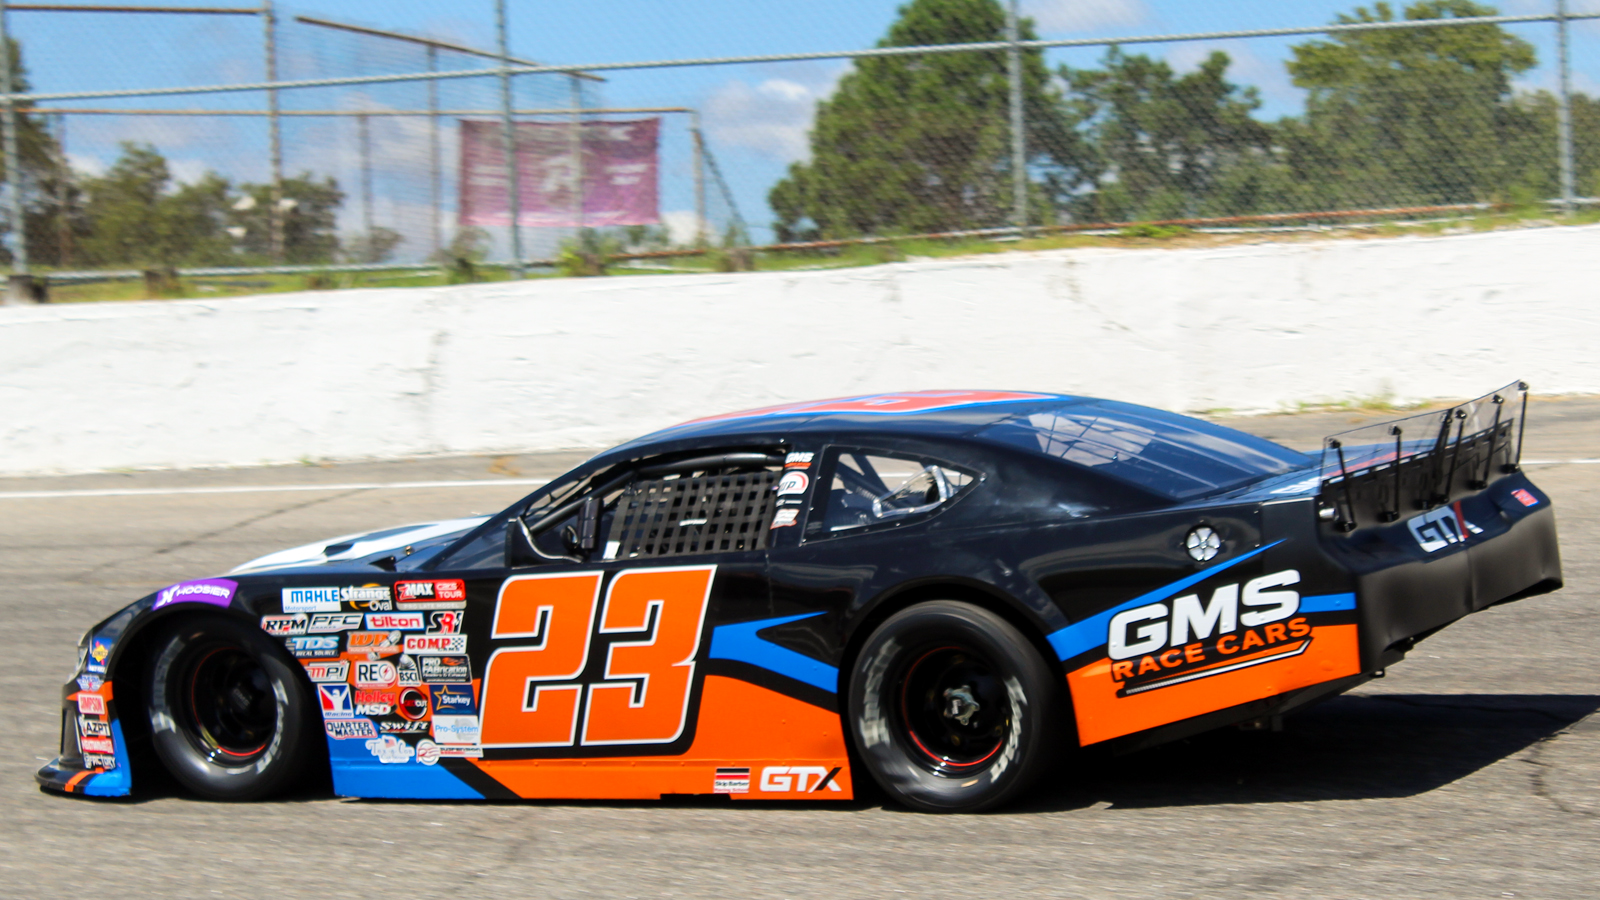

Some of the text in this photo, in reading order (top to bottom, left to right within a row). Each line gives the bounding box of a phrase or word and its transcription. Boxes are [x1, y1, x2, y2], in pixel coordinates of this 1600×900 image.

[1407, 500, 1484, 553] GTX
[176, 584, 230, 599] HOOSIER
[291, 589, 339, 603] MAHLE
[340, 585, 391, 601] Strange
[438, 591, 463, 599] TOUR
[369, 600, 393, 611] Oval
[313, 615, 361, 626] PFC
[1108, 569, 1300, 660] GMS
[265, 619, 306, 631] RPM
[370, 616, 420, 628] tilton
[292, 636, 339, 650] TDS
[406, 638, 451, 649] COMP
[1111, 617, 1311, 681] RACE CARS
[422, 657, 440, 666] PRO
[478, 564, 718, 749] 23
[400, 672, 417, 681] BSCI
[354, 690, 396, 706] Holley
[441, 695, 471, 706] Starkey
[355, 704, 392, 715] MSD
[326, 722, 370, 731] QUARTER
[435, 724, 478, 734] Pro-System
[760, 766, 843, 793] GTX
